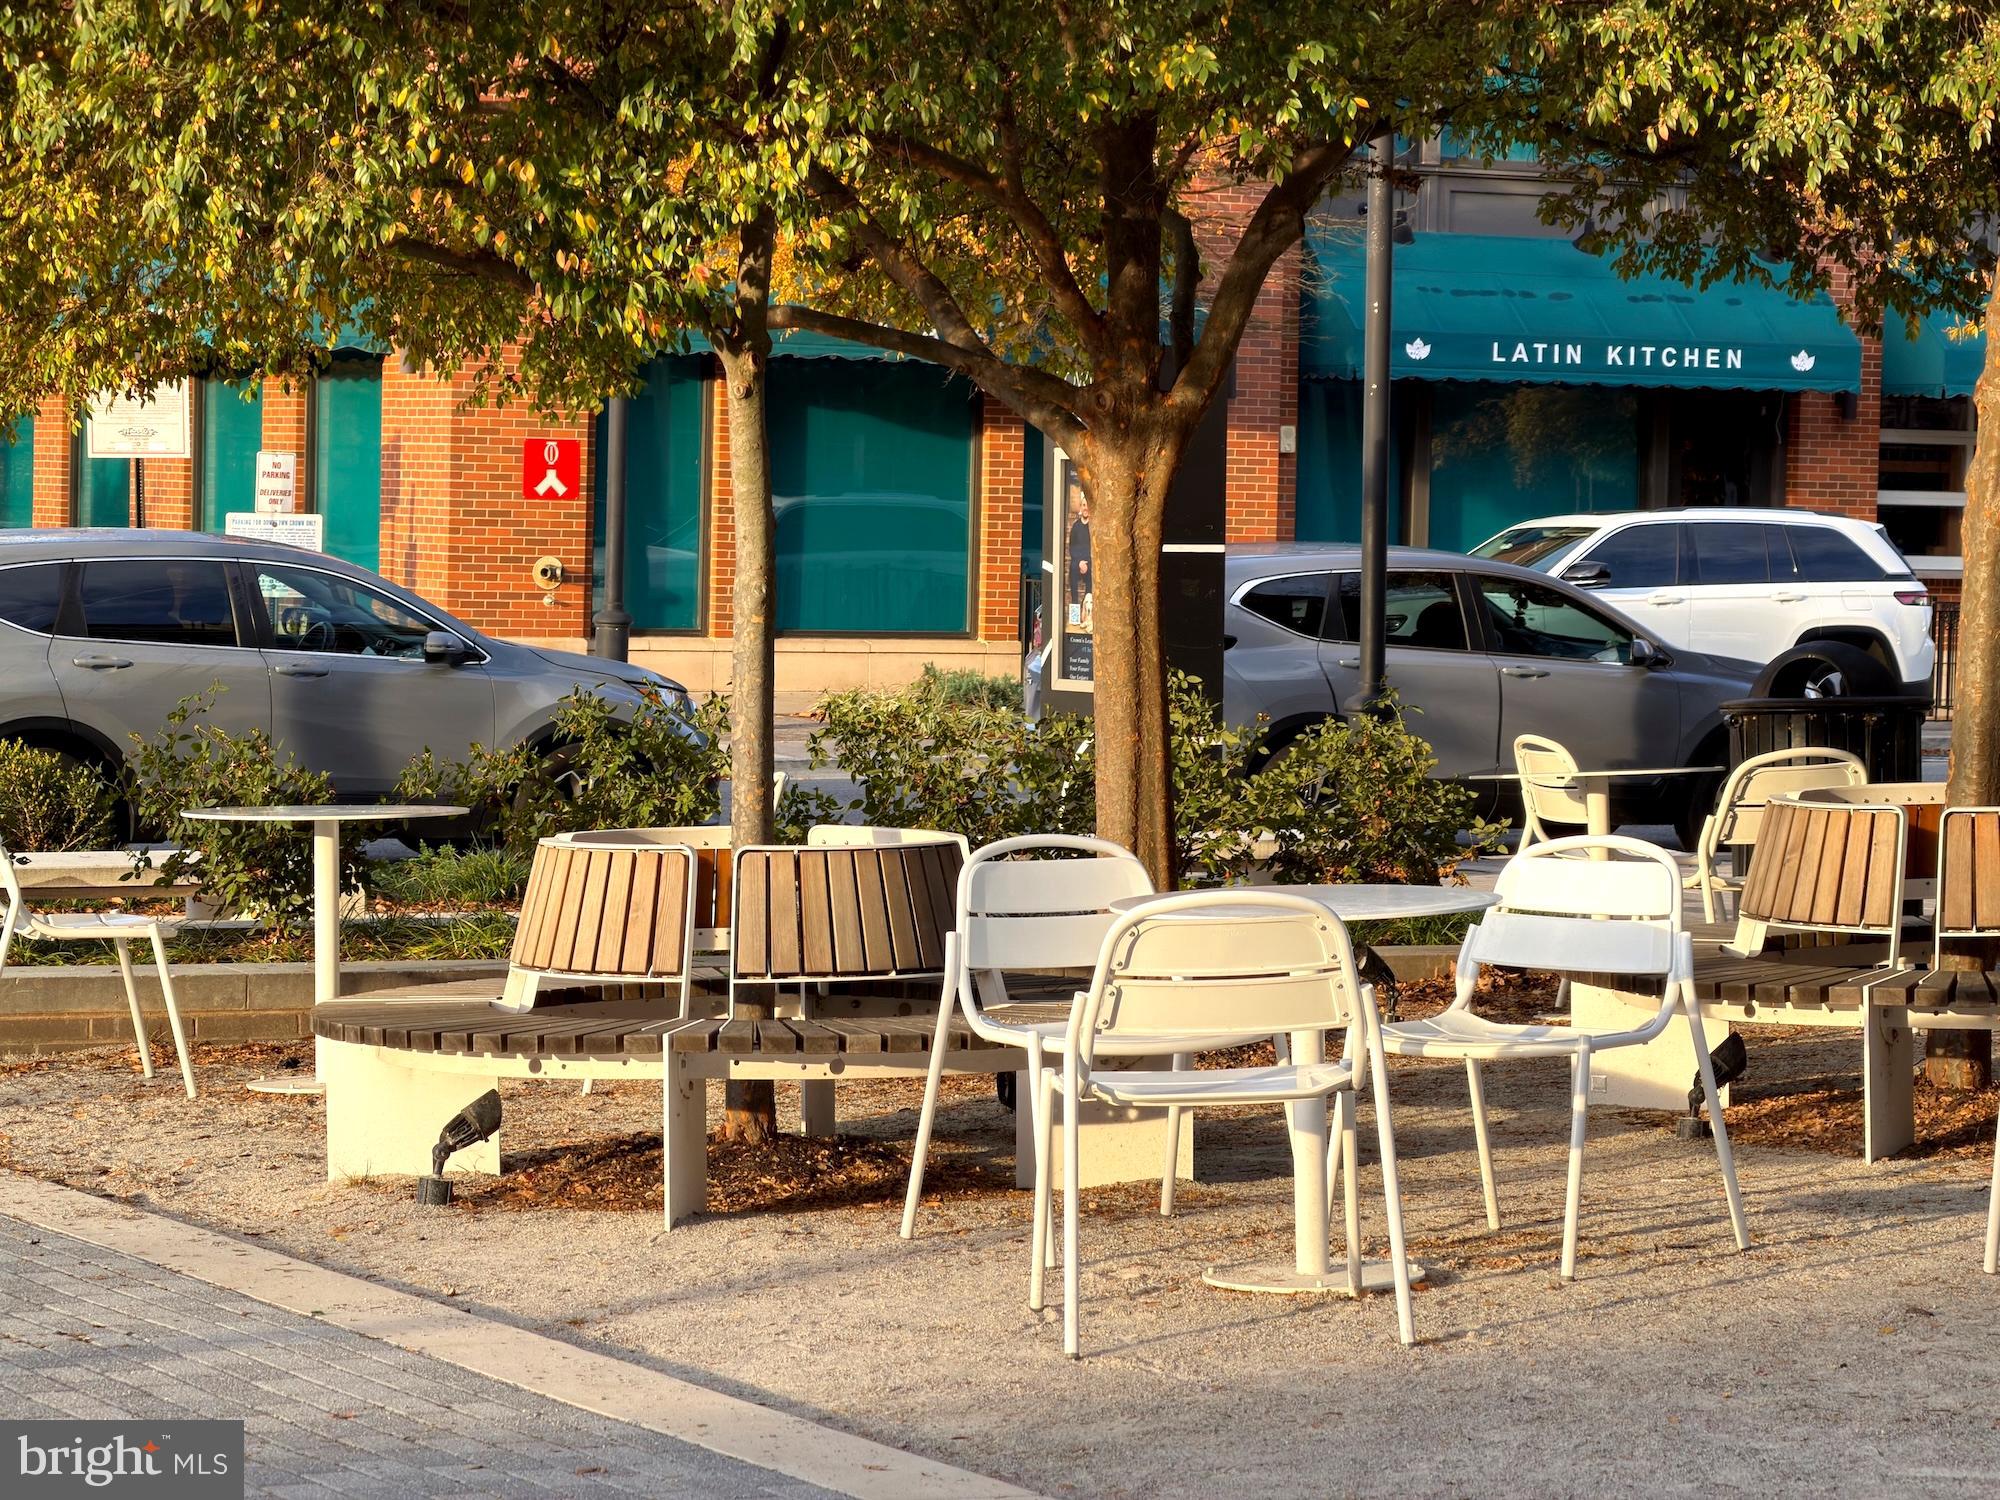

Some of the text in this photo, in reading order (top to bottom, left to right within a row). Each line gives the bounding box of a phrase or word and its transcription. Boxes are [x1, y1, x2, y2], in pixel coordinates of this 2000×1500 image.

[1492, 341, 1743, 369] LATIN KITCHEN
[272, 461, 281, 469] NO
[262, 471, 290, 479] PARKING
[260, 489, 292, 497] DELIVERIES
